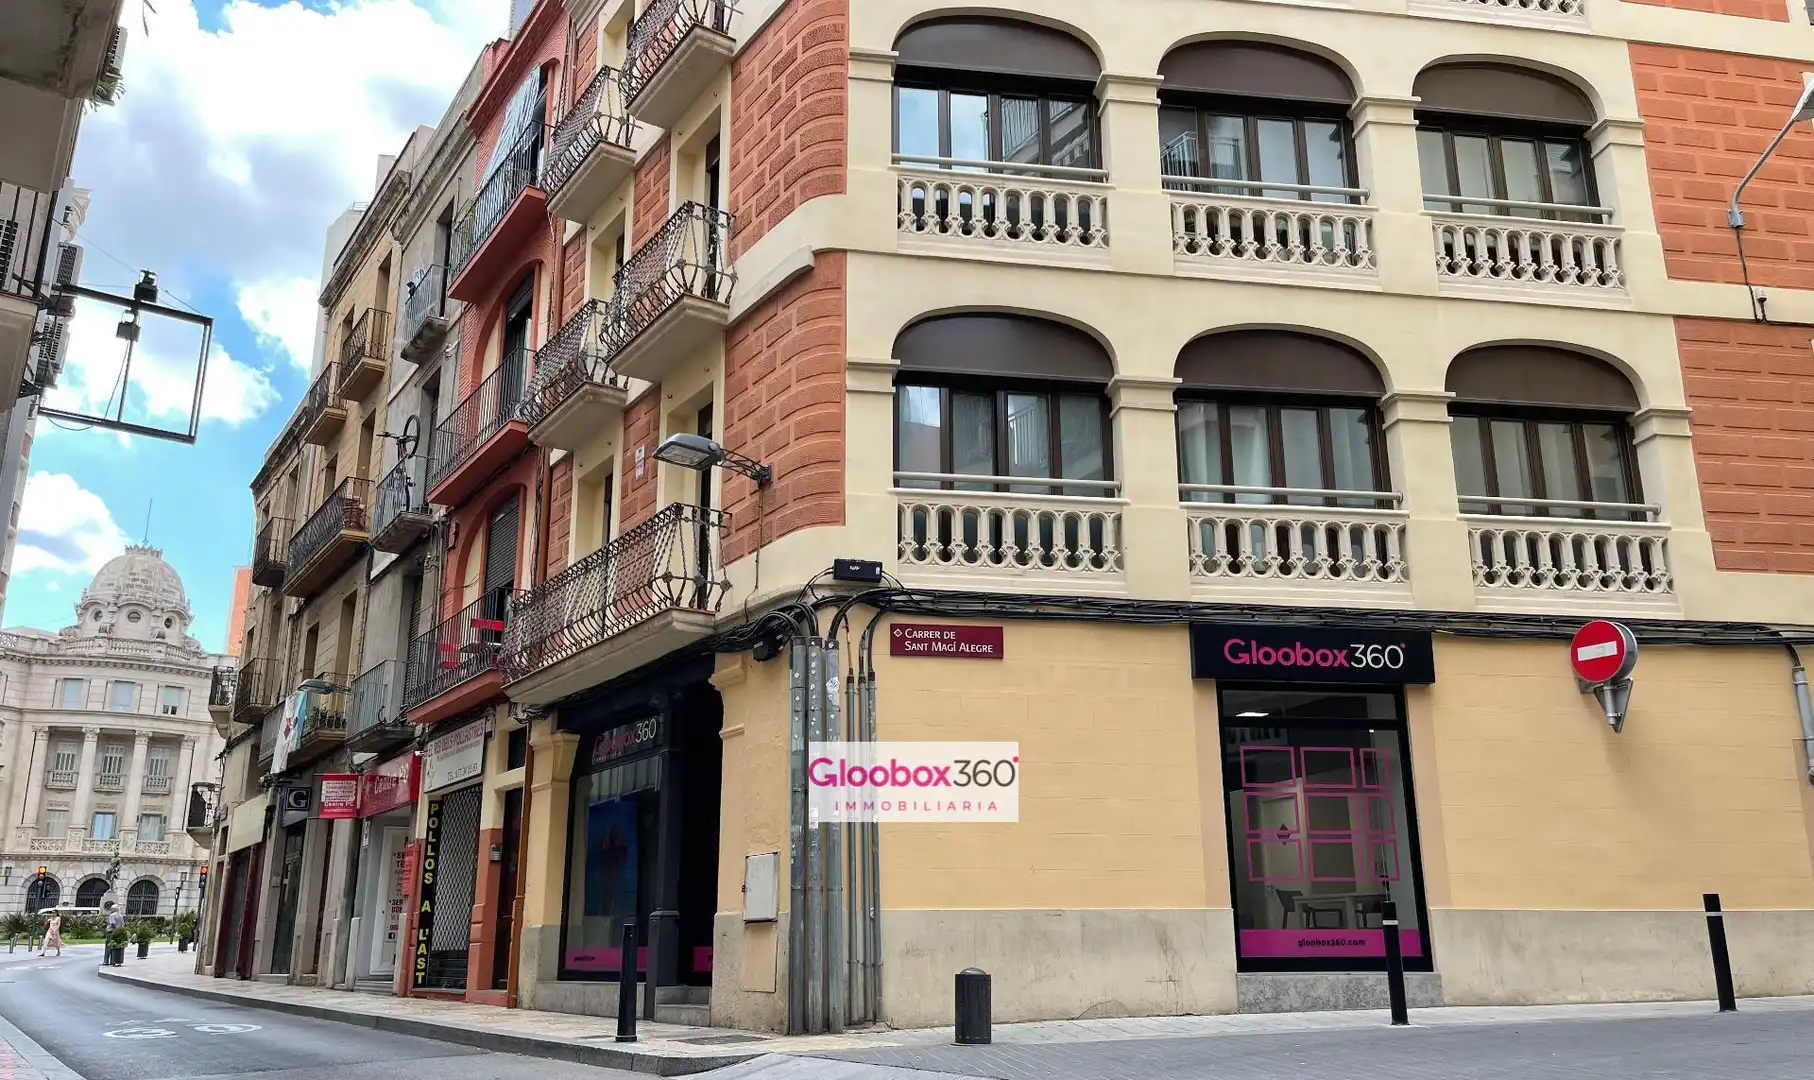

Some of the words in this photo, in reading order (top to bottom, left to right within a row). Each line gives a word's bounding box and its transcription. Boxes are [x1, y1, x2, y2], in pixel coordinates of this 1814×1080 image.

[904, 628, 941, 639] CARRER
[1223, 638, 1405, 669] Gloobox360
[374, 772, 397, 795] Centre
[289, 790, 307, 808] G
[424, 803, 440, 885] POLLOS
[421, 900, 431, 912] A
[1297, 938, 1366, 948] gloobox360.com
